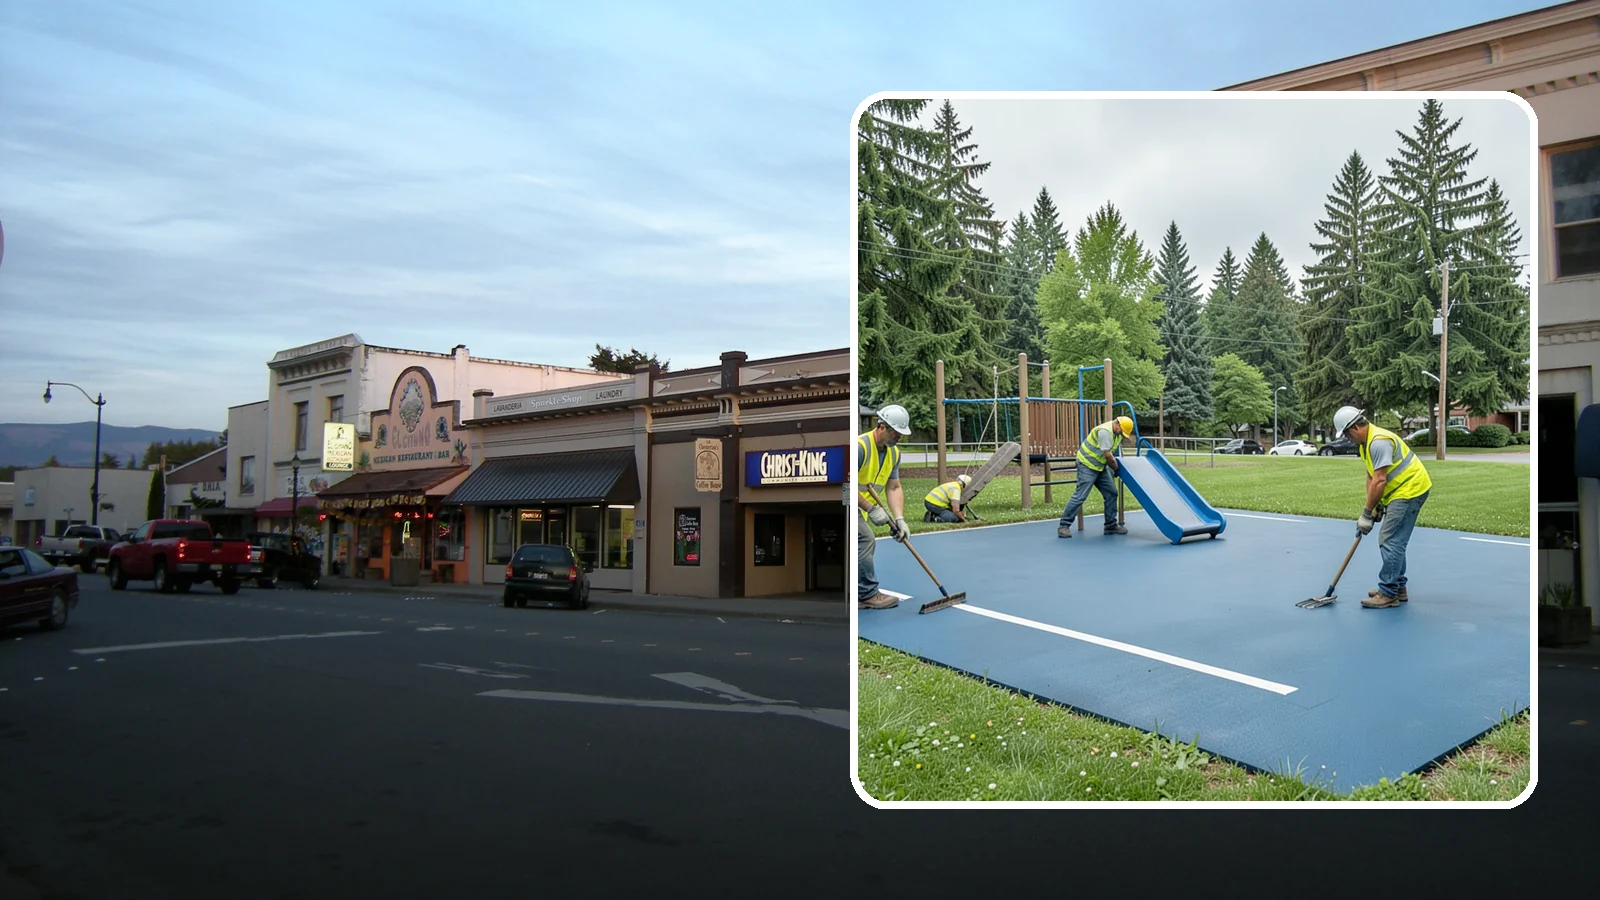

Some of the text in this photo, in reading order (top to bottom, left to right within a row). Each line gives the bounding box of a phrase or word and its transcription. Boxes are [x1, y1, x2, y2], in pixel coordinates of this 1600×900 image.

[561, 395, 582, 405] Shop
[595, 389, 623, 400] LAUNDRY
[493, 402, 522, 412] LAVANDERIA
[373, 455, 396, 464] MEXICAN
[397, 451, 433, 462] RESTAURANT
[437, 450, 450, 459] BAR
[799, 450, 827, 476] KING
